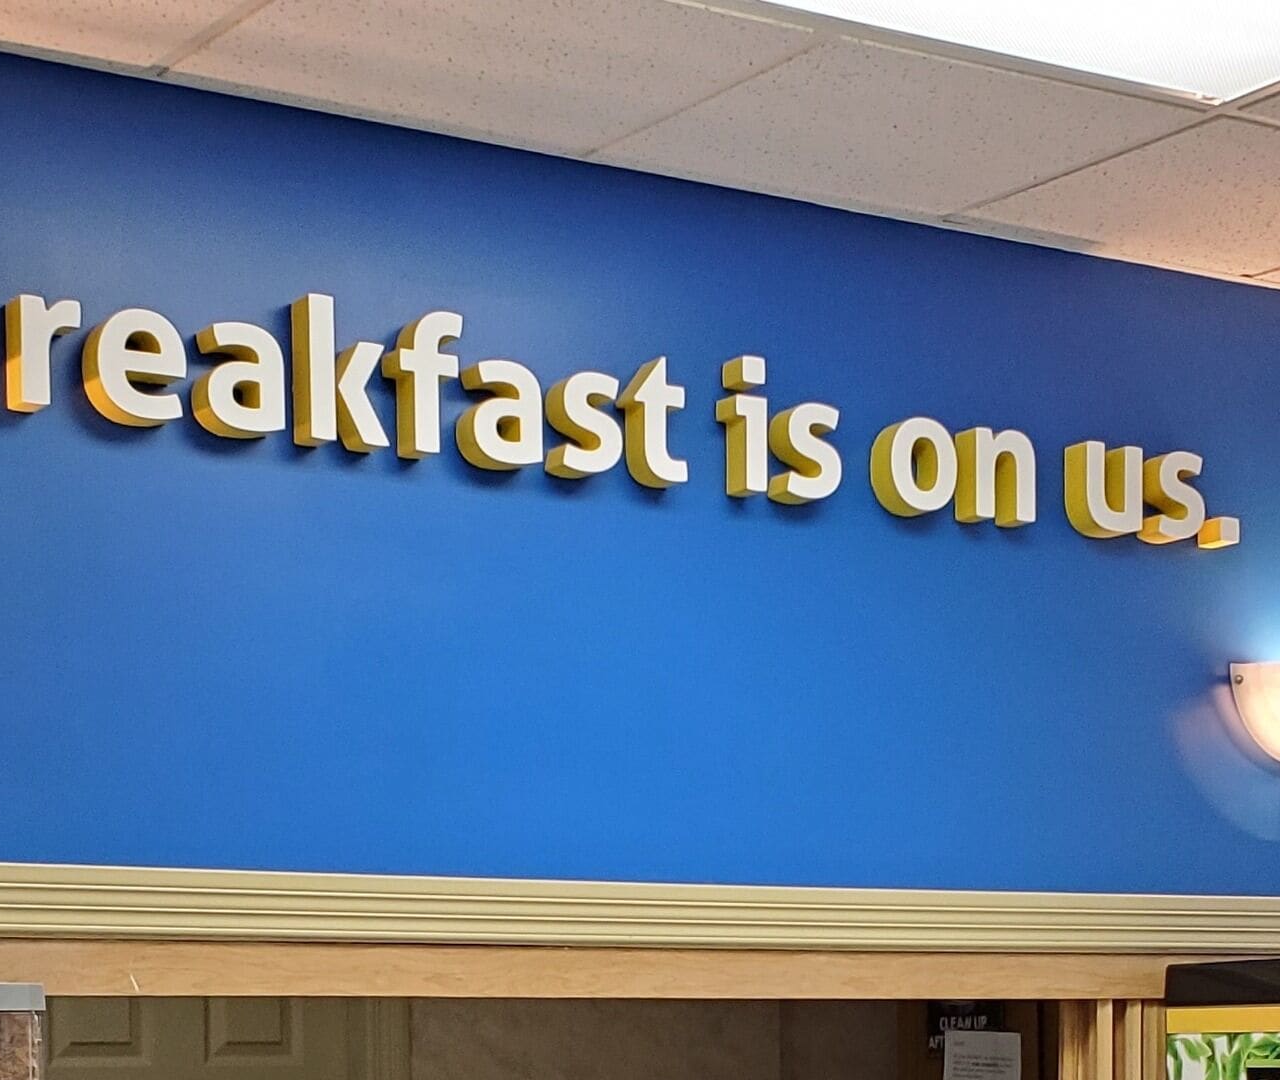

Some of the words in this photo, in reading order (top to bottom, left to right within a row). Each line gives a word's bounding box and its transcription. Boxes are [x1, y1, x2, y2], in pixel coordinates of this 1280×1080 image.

[716, 355, 842, 505] is
[870, 417, 1036, 528] on
[1064, 440, 1240, 549] us.
[939, 1016, 972, 1031] CLEAN
[974, 1015, 988, 1030] UP
[928, 1036, 945, 1049] AFT
